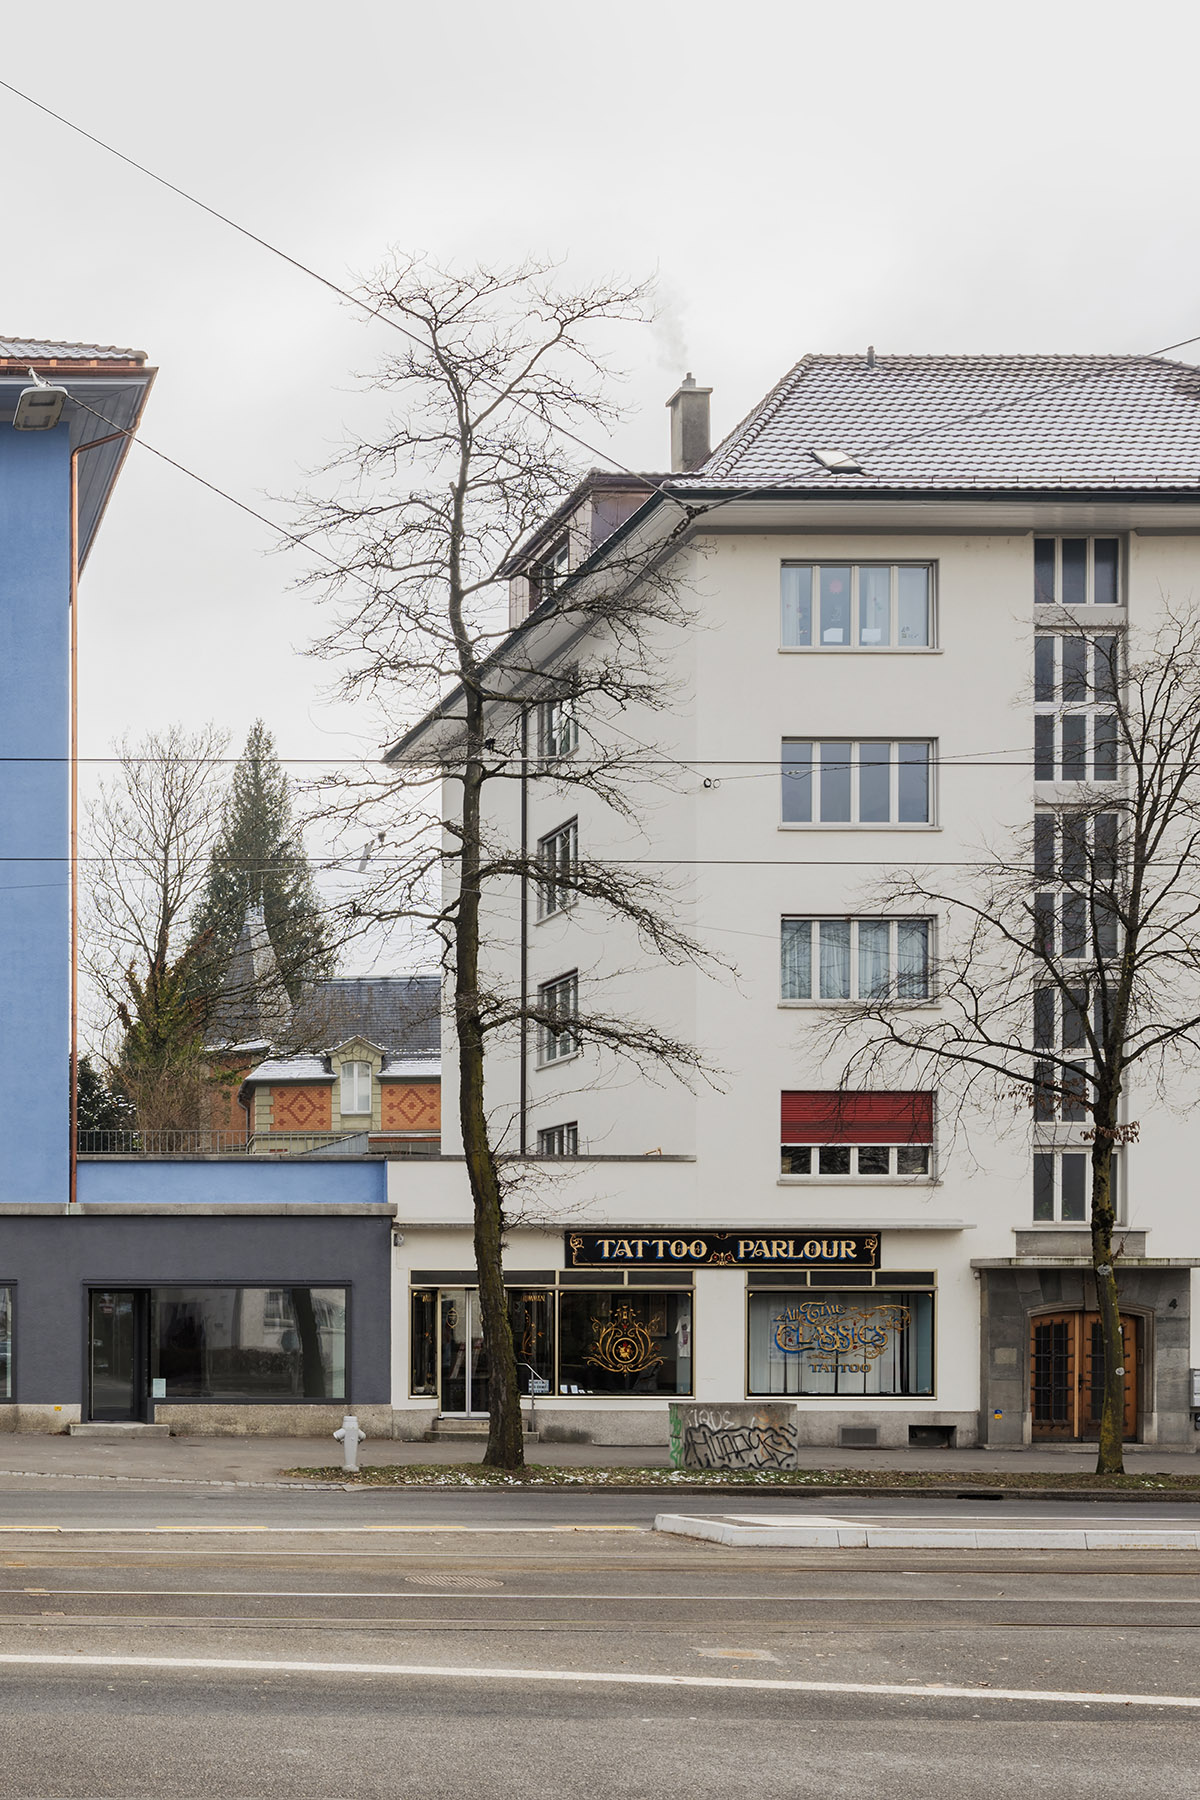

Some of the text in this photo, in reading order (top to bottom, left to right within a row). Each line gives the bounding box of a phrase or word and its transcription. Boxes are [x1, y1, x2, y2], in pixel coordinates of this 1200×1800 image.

[596, 1239, 857, 1260] TATTOO PARLOUR
[1168, 1298, 1178, 1309] 4
[809, 1363, 872, 1374] TATTOO
